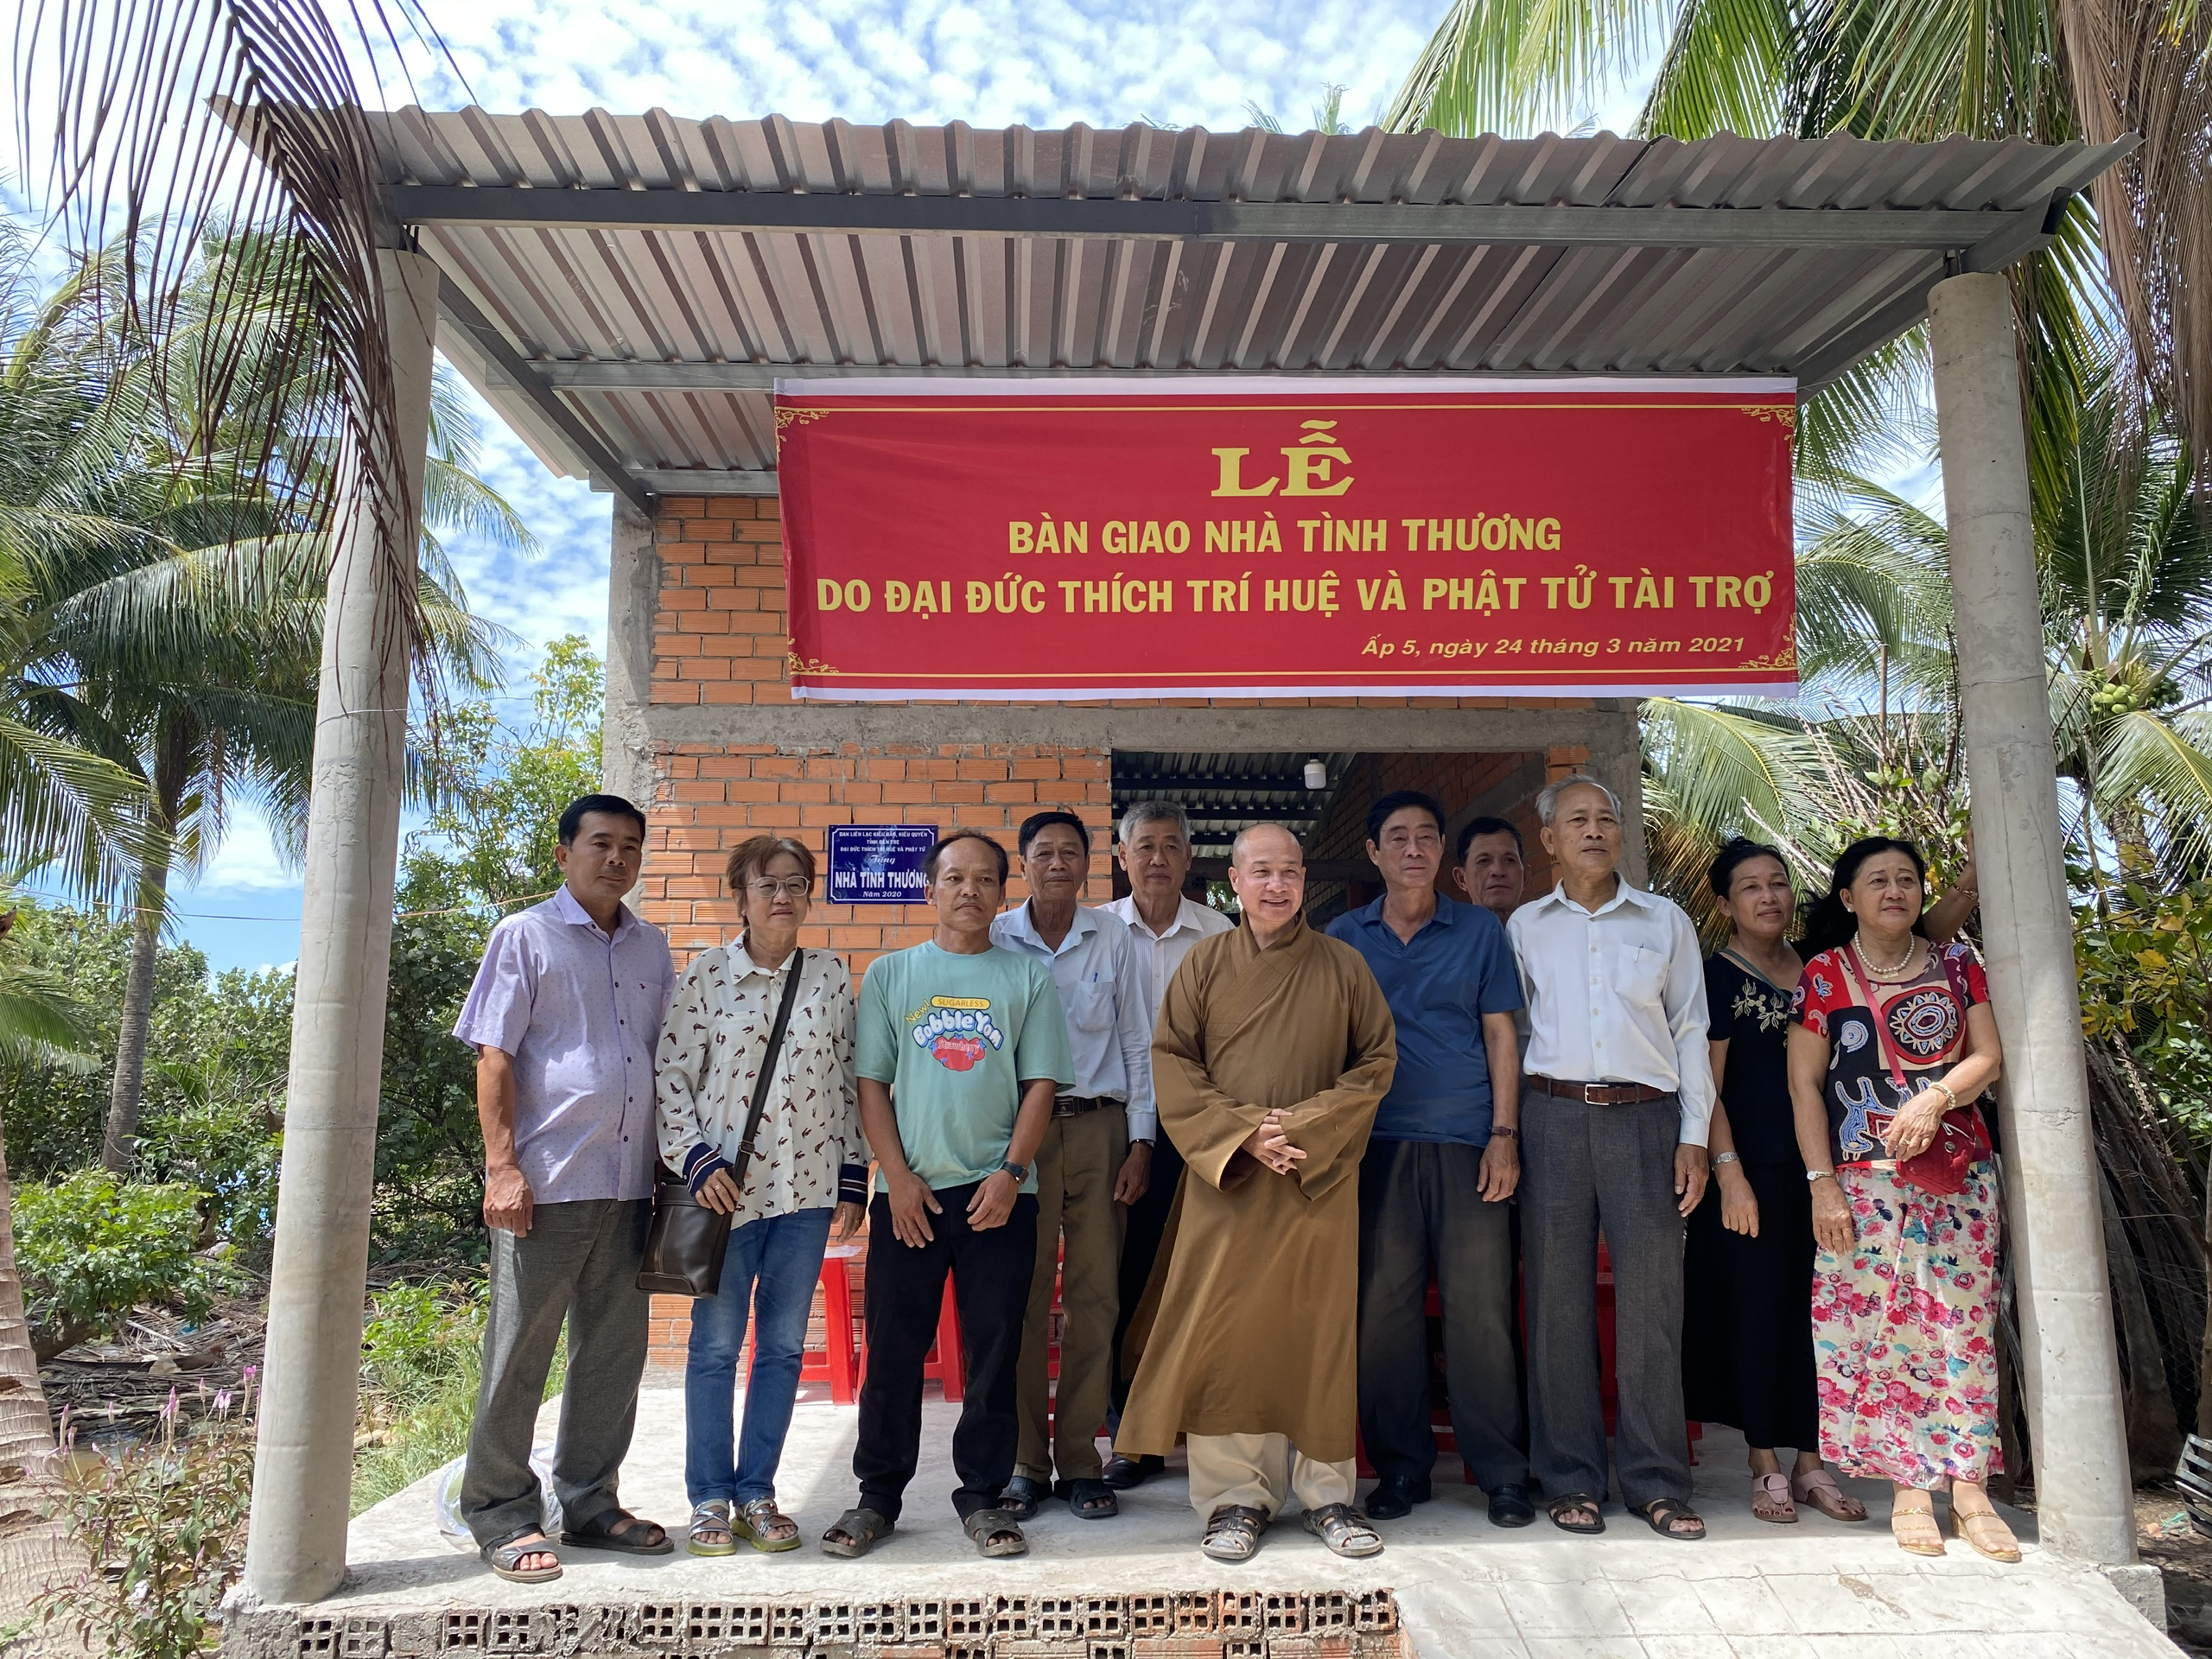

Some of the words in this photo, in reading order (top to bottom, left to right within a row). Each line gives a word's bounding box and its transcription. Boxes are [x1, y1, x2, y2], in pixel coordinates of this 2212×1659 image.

[1211, 419, 1355, 497] LỄ
[1008, 512, 1088, 554] BÀN
[1102, 520, 1191, 554] GIAO
[1205, 511, 1282, 553] NHÀ
[1296, 511, 1388, 552] TÌNH
[1402, 512, 1561, 551] THƯƠNG
[817, 578, 871, 613] DO
[884, 580, 951, 620] ĐẠI
[965, 571, 1046, 613] ĐỨC
[1058, 572, 1173, 613] THÍCH
[1186, 571, 1252, 613] TRÍ
[1264, 569, 1340, 618] HUỆ
[1357, 569, 1407, 611] VÀ
[1423, 569, 1527, 617] PHẬT
[1541, 563, 1598, 610] TỬ
[1608, 568, 1674, 609] TÀI
[1688, 570, 1775, 614] TRỢ
[1361, 632, 1395, 659] Ấp
[1402, 639, 1421, 658] 5,
[1429, 638, 1489, 659] ngày
[1494, 639, 1522, 654] 24
[1530, 637, 1599, 658] tháng
[1606, 638, 1621, 653] 3
[1627, 638, 1680, 653] năm
[1688, 637, 1745, 653] 2021
[835, 867, 857, 888] NHÀ
[860, 867, 885, 888] TÌNH
[905, 999, 931, 1026] New!
[938, 998, 984, 1007] SUGARLESS
[938, 1039, 980, 1054] Strawberry
